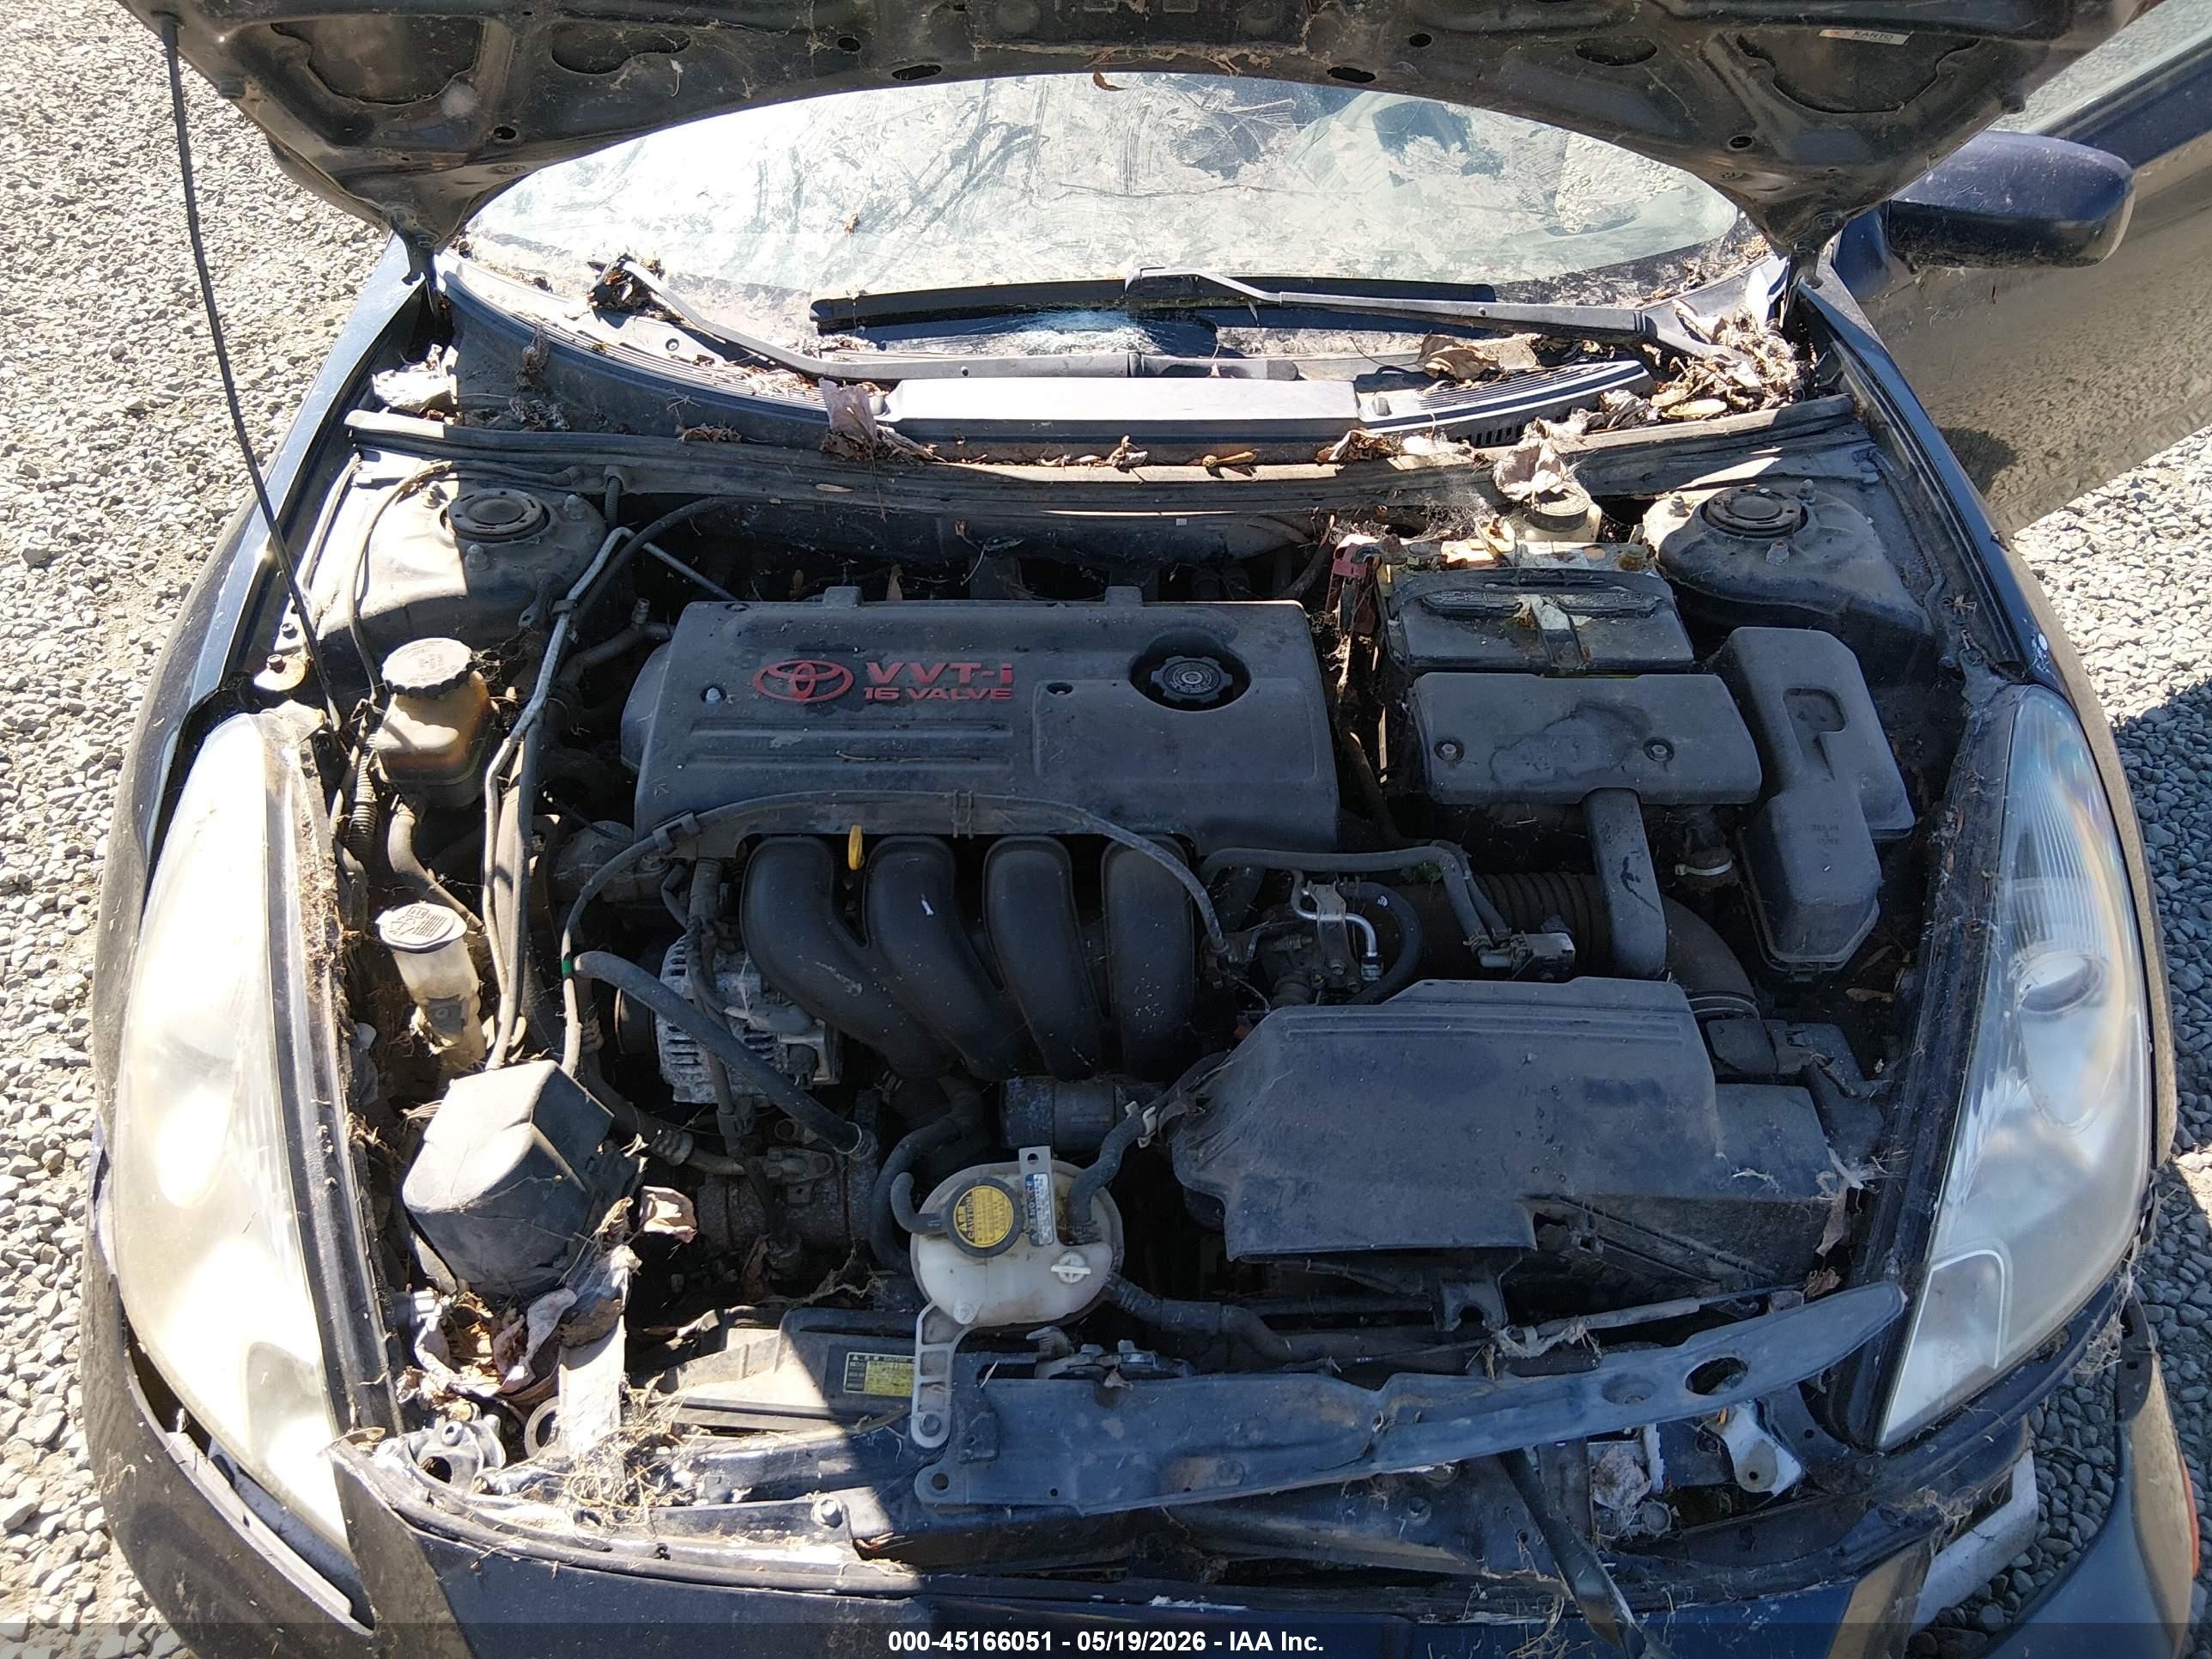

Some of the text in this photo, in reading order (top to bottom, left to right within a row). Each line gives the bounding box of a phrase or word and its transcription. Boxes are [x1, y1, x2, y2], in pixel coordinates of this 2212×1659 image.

[1853, 31, 1894, 40] KANTO
[865, 661, 1014, 684] VVT-i
[864, 687, 1013, 701] 16 VALVE
